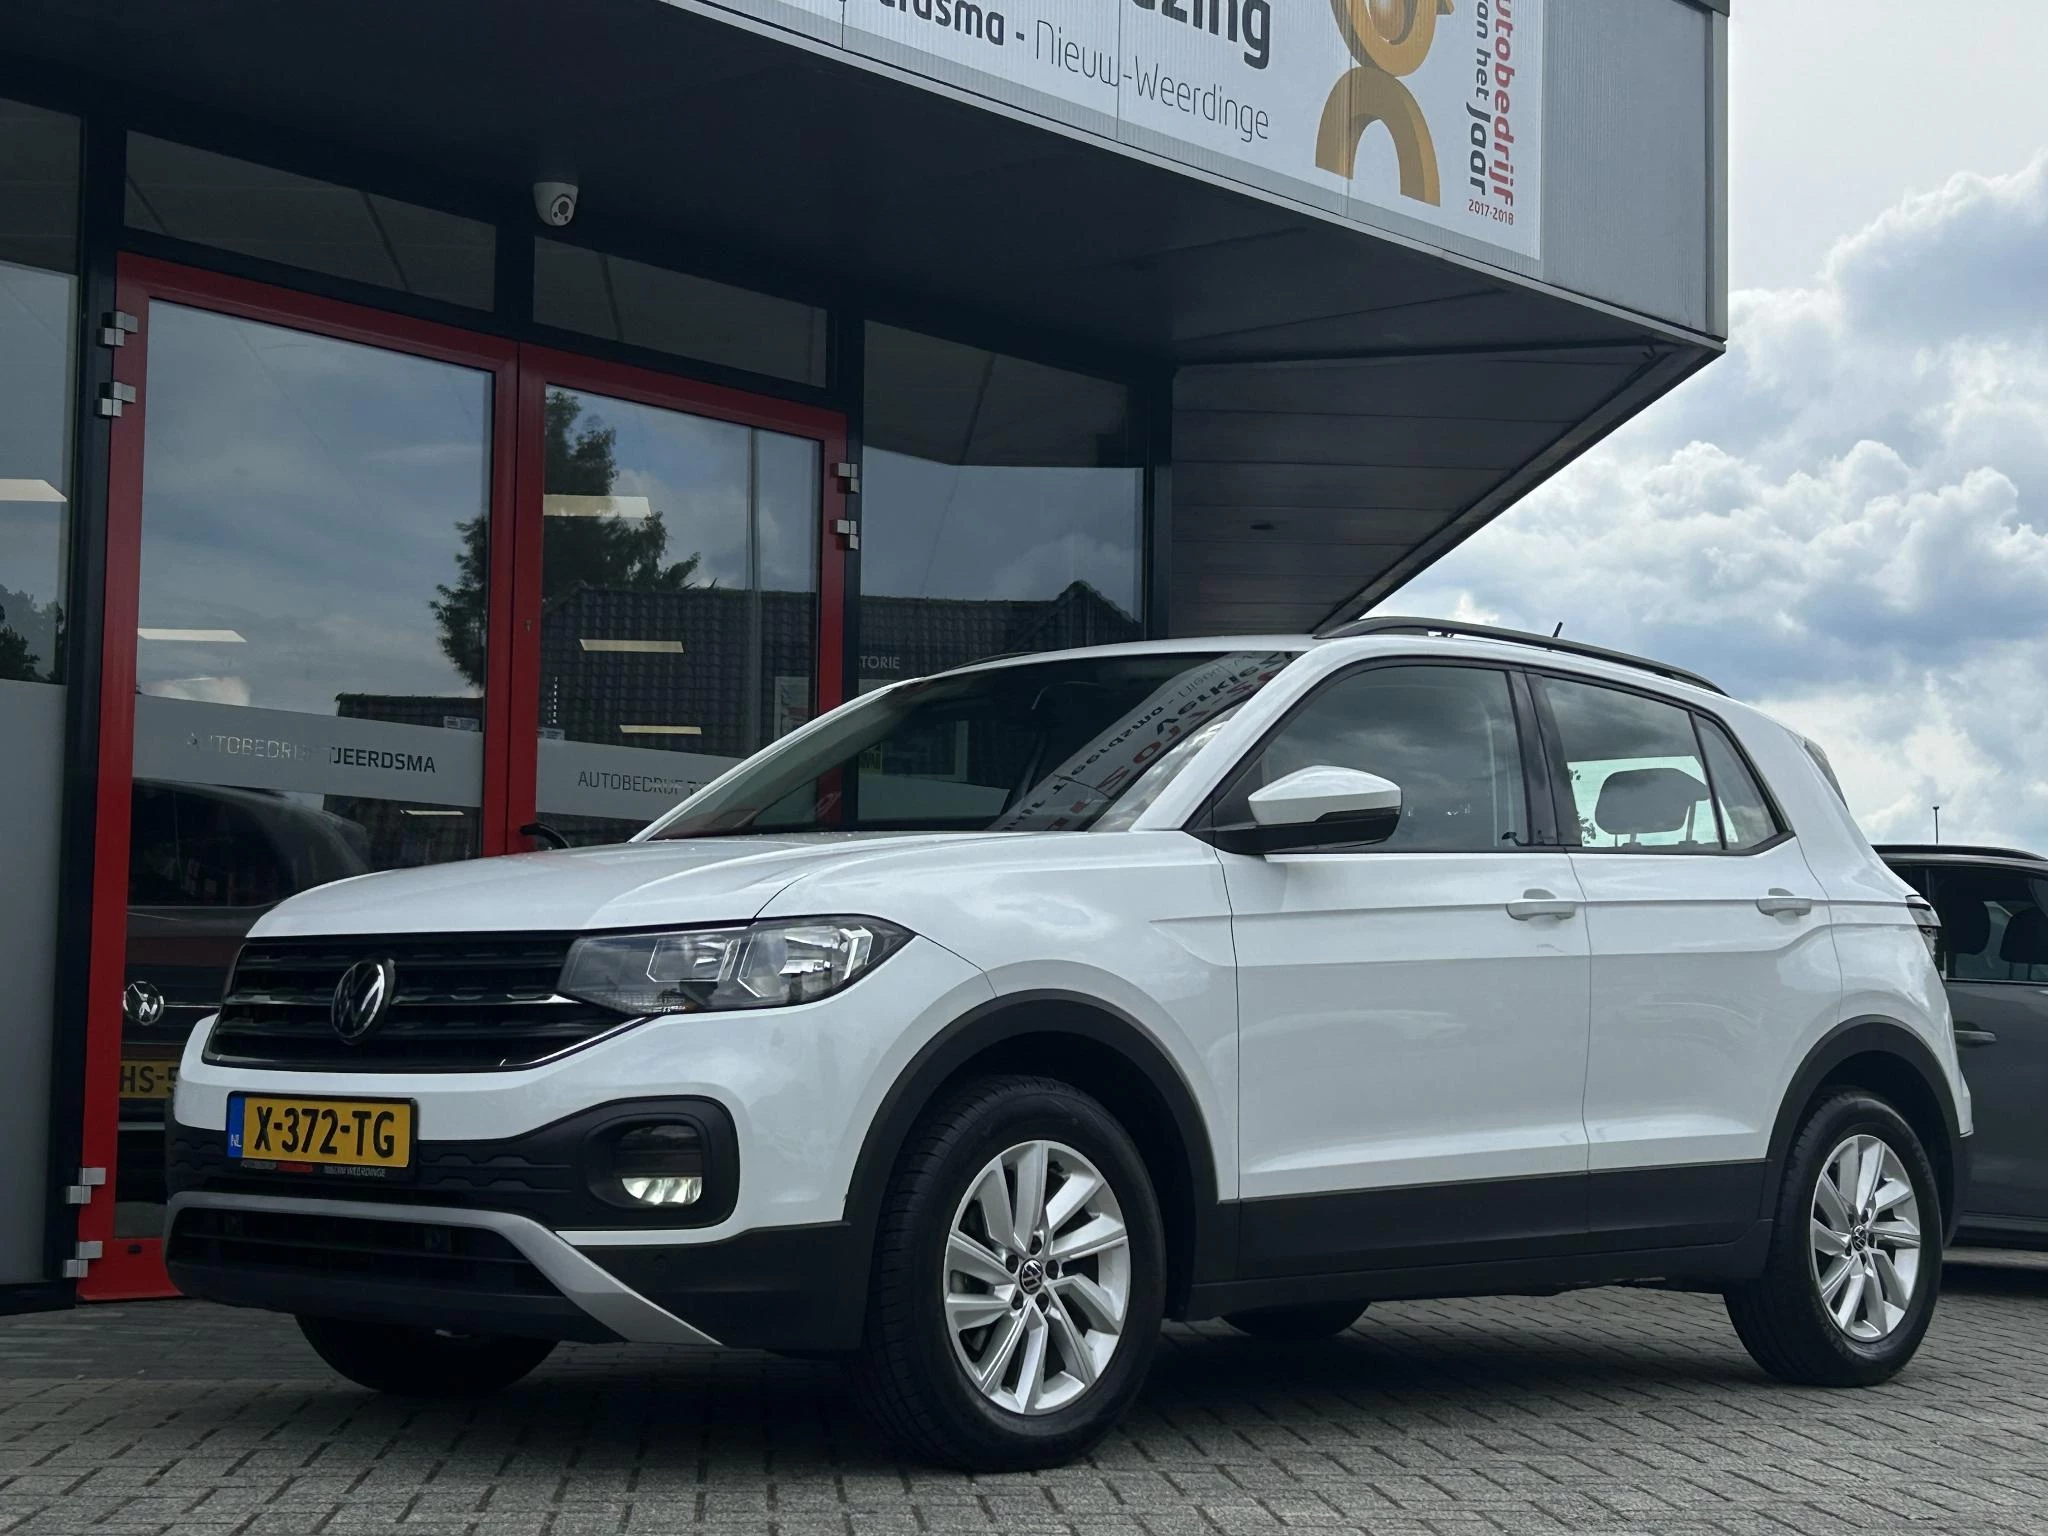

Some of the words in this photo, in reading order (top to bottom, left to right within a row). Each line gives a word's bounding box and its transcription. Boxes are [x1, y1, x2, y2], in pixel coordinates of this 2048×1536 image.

[1132, 0, 1271, 70] zing
[1476, 0, 1489, 39] an
[1036, 19, 1270, 143] Nieuw-Weerdinge
[1476, 48, 1492, 100] het
[1468, 199, 1515, 226] 2017-2018
[253, 1105, 396, 1159] X-372-TG
